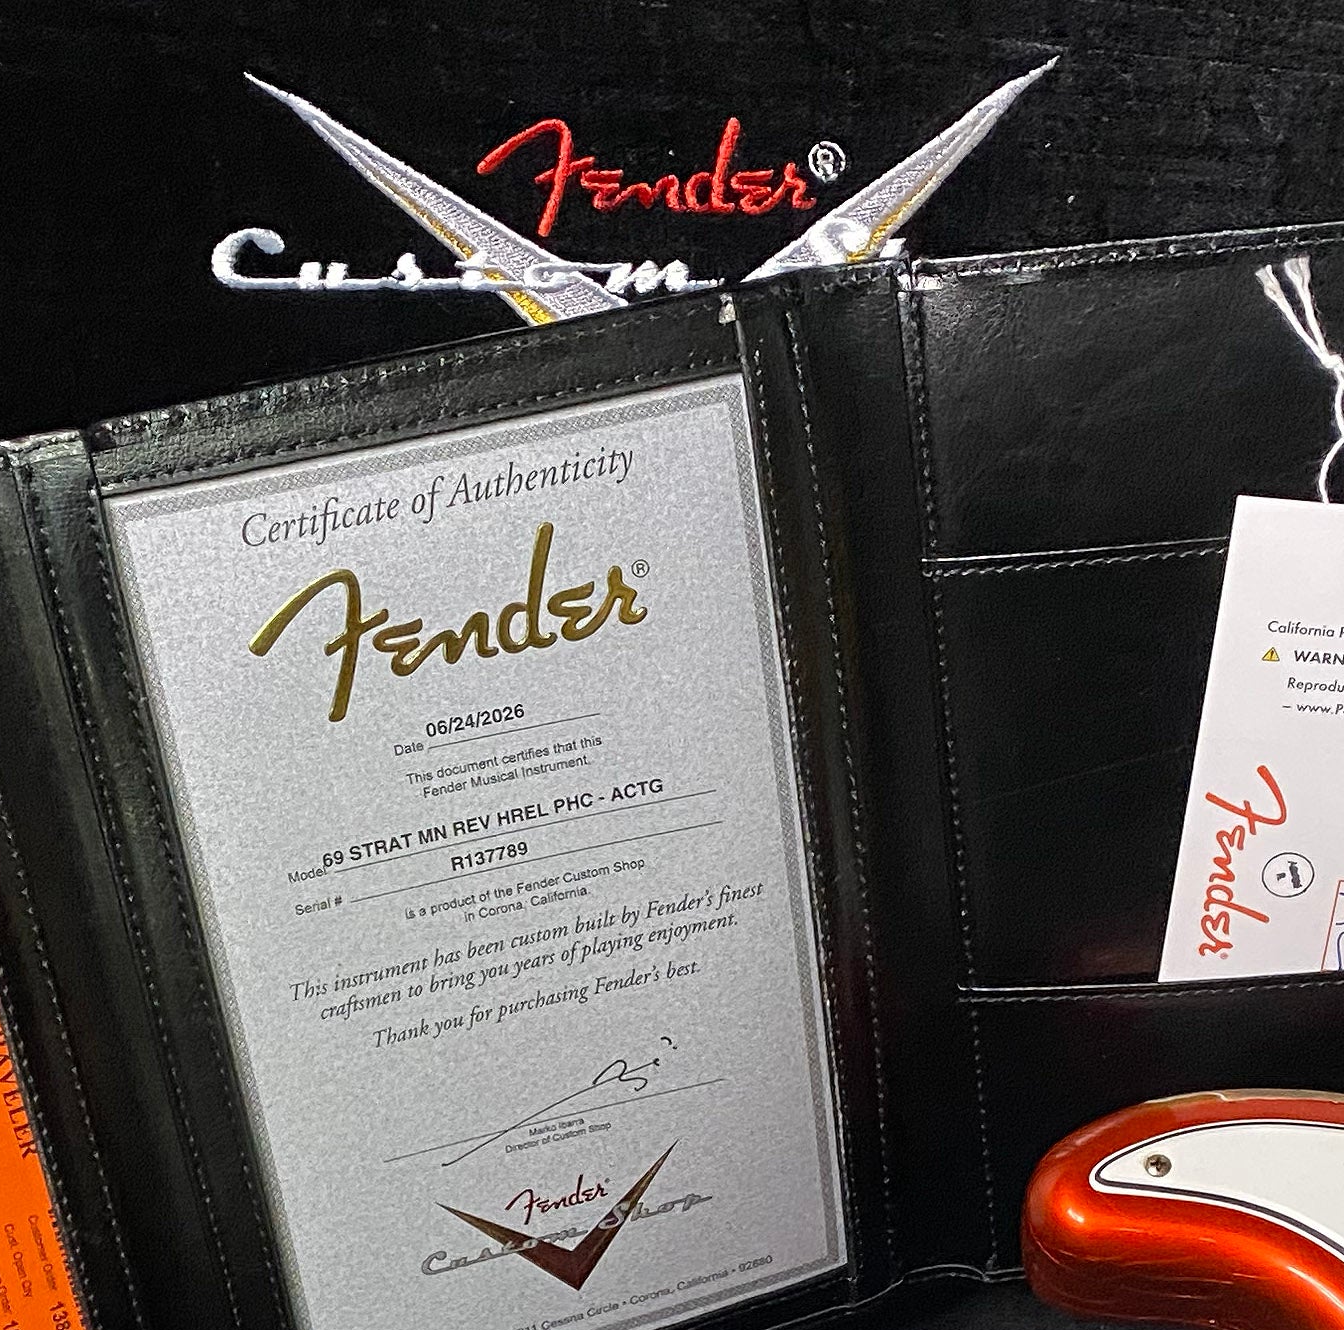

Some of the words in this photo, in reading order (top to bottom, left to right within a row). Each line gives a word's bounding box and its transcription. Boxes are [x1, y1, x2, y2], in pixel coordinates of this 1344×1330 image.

[241, 496, 400, 547] Certificate
[411, 475, 445, 525] of
[447, 446, 634, 509] Authenticity
[1268, 621, 1334, 637] California
[393, 741, 425, 757] Date
[425, 703, 525, 738] 06/24/2026
[405, 772, 434, 785] This
[436, 756, 499, 779] document
[501, 747, 550, 765] certifies
[552, 740, 578, 754] that
[579, 735, 603, 750] this
[422, 780, 468, 799] Fender
[470, 768, 519, 788] Musical
[520, 754, 592, 779] Instrument.
[287, 862, 329, 884] Model
[322, 850, 345, 872] 69
[349, 832, 413, 861] STRAT
[417, 824, 448, 845] MN
[452, 814, 490, 837] REV
[496, 803, 550, 827] HREL
[553, 792, 594, 814] PHC
[610, 778, 664, 802] ACTG
[1199, 766, 1287, 959] Fender
[294, 896, 332, 916] Serial
[334, 895, 343, 907] #
[450, 841, 528, 872] R137789
[430, 894, 477, 917] product
[478, 889, 491, 903] of
[493, 887, 513, 899] the
[516, 876, 561, 895] Fender
[562, 866, 611, 884] Custom
[613, 859, 645, 873] Shop
[289, 978, 329, 1002] This
[334, 957, 429, 992] instrument
[433, 950, 463, 968] has
[467, 939, 505, 959] been
[510, 925, 569, 949] custom
[574, 912, 617, 934] built
[621, 908, 641, 929] by
[715, 882, 764, 911] finest
[463, 911, 476, 923] in
[320, 989, 402, 1021] craftsmen
[407, 984, 424, 998] to
[429, 971, 476, 993] bring
[479, 965, 509, 987] you
[512, 955, 555, 979] years
[560, 944, 585, 967] of
[581, 932, 644, 963] playing
[647, 913, 738, 946] enjoyment.
[372, 1019, 430, 1048] Thank
[432, 1015, 469, 1040] you
[469, 1005, 493, 1030] for
[495, 984, 590, 1024] purchasing
[666, 960, 701, 979] best.
[504, 1174, 609, 1225] Fender
[420, 1228, 589, 1276] Custom
[597, 1193, 713, 1230] Shop
[676, 1269, 730, 1291] California
